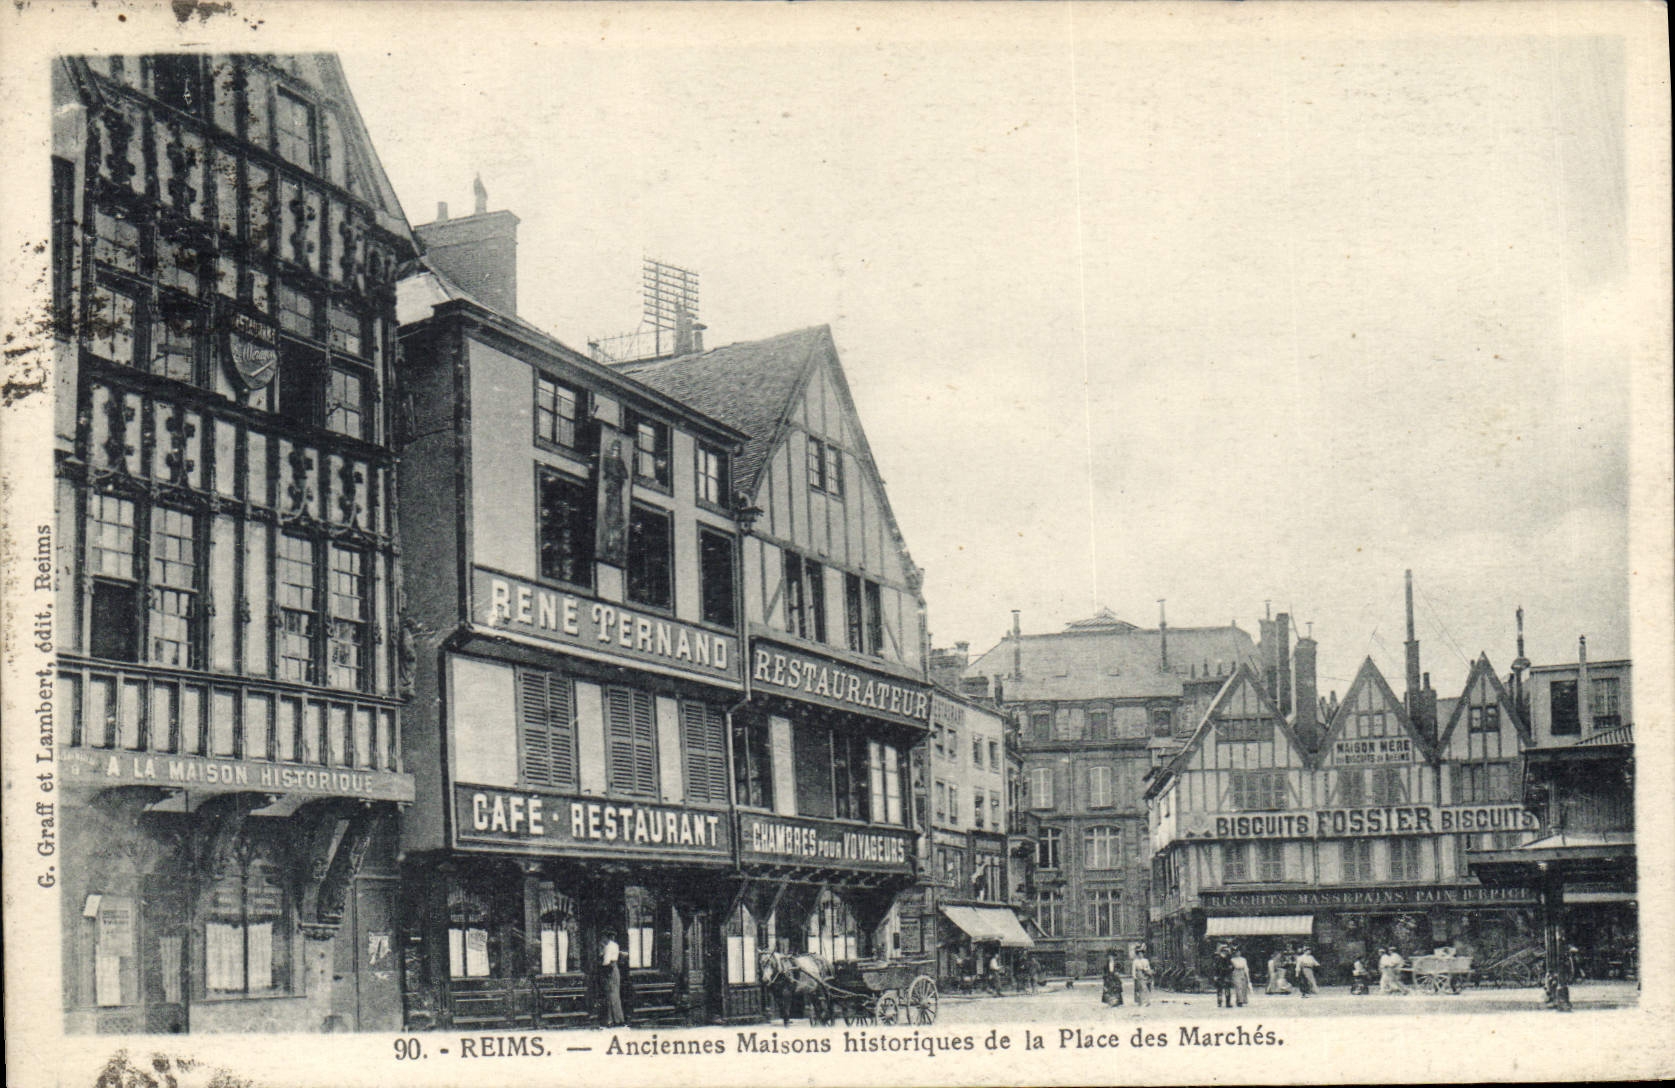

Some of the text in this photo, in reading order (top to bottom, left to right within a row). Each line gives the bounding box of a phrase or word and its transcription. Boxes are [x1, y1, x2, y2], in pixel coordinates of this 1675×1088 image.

[489, 579, 728, 670] RENÉ TERNAND
[754, 649, 929, 720] RESTAURATEUR
[1336, 741, 1375, 753] MAISON
[106, 755, 121, 777] A
[133, 757, 156, 779] LA
[168, 760, 248, 785] MAISON
[261, 766, 373, 793] HISTORIQUE
[472, 792, 719, 847] CAFÉ RESTAURANT
[1215, 807, 1433, 837] BISCUITS FOSSIER
[1440, 807, 1533, 830] BISCUITS
[752, 822, 905, 863] CHAMBRES POUR VOYAGEURS
[1211, 893, 1288, 906] BISCUITS
[1298, 890, 1404, 905] MASSEPAINS
[1416, 889, 1454, 901] PAIN
